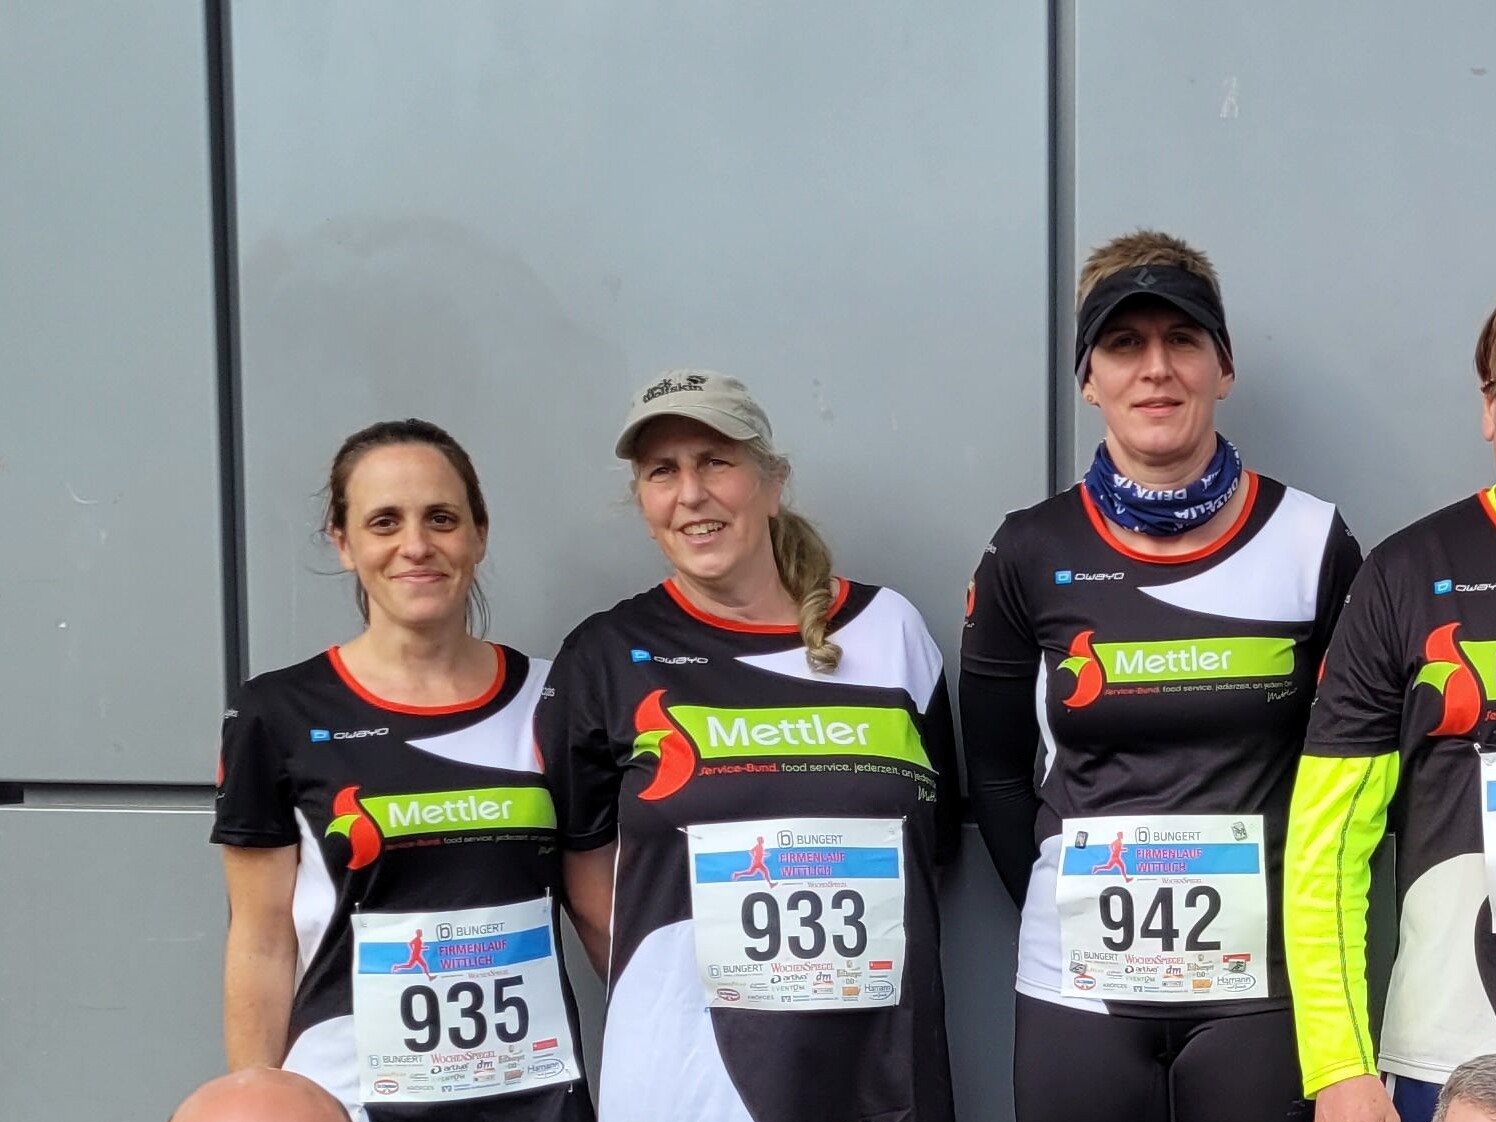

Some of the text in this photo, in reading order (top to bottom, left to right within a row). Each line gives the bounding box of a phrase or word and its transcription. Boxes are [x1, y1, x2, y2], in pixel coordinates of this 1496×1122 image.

[1114, 646, 1232, 675] Mettler
[707, 714, 869, 747] Mettler
[781, 763, 808, 772] food
[811, 762, 852, 771] service.
[388, 795, 513, 828] Mettler
[797, 835, 843, 844] BUNGERT
[1154, 832, 1201, 841] BUNGERT
[1099, 886, 1221, 952] 942
[457, 923, 505, 936] BUNGERT
[742, 890, 868, 961] 933
[439, 940, 507, 955] FIRMENLAUF
[1084, 952, 1118, 960] BUNGERT
[441, 957, 492, 969] WITTLICH
[724, 964, 763, 973] BUNGERT
[1166, 966, 1181, 975] dm
[816, 972, 831, 981] dm
[400, 975, 529, 1052] 935
[383, 1055, 423, 1063] BUNGERT
[477, 1061, 492, 1069] dm
